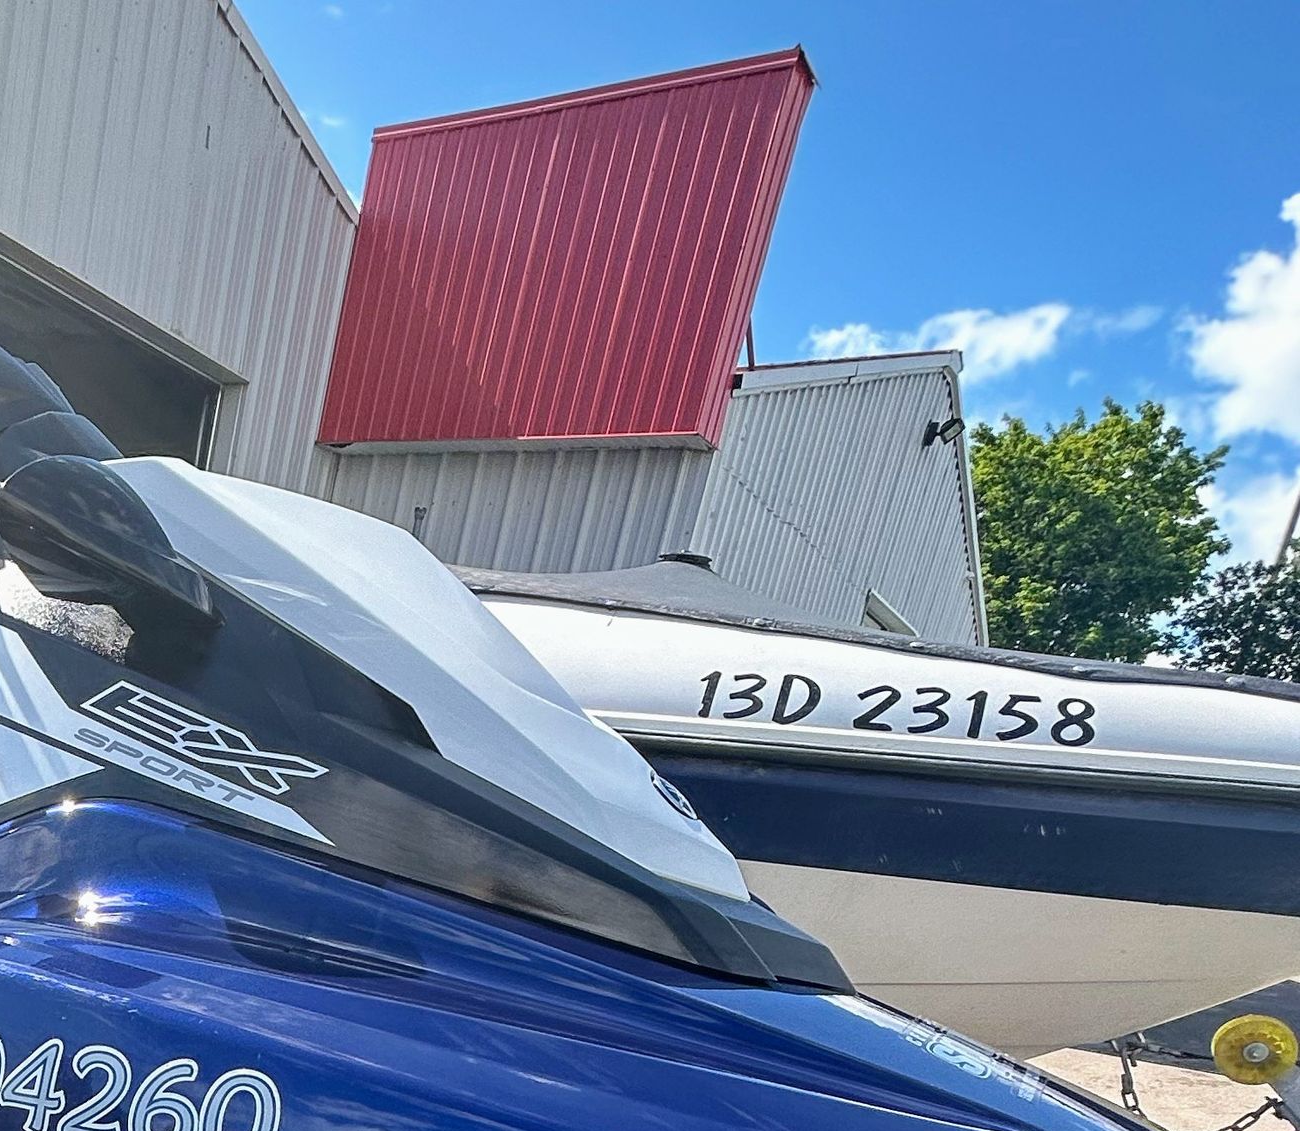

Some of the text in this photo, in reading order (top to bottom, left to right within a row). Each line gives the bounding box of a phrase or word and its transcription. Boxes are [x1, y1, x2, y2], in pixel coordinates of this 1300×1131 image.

[80, 679, 330, 795] EX
[697, 671, 1096, 747] 13D 23158
[74, 728, 255, 803] SPORT
